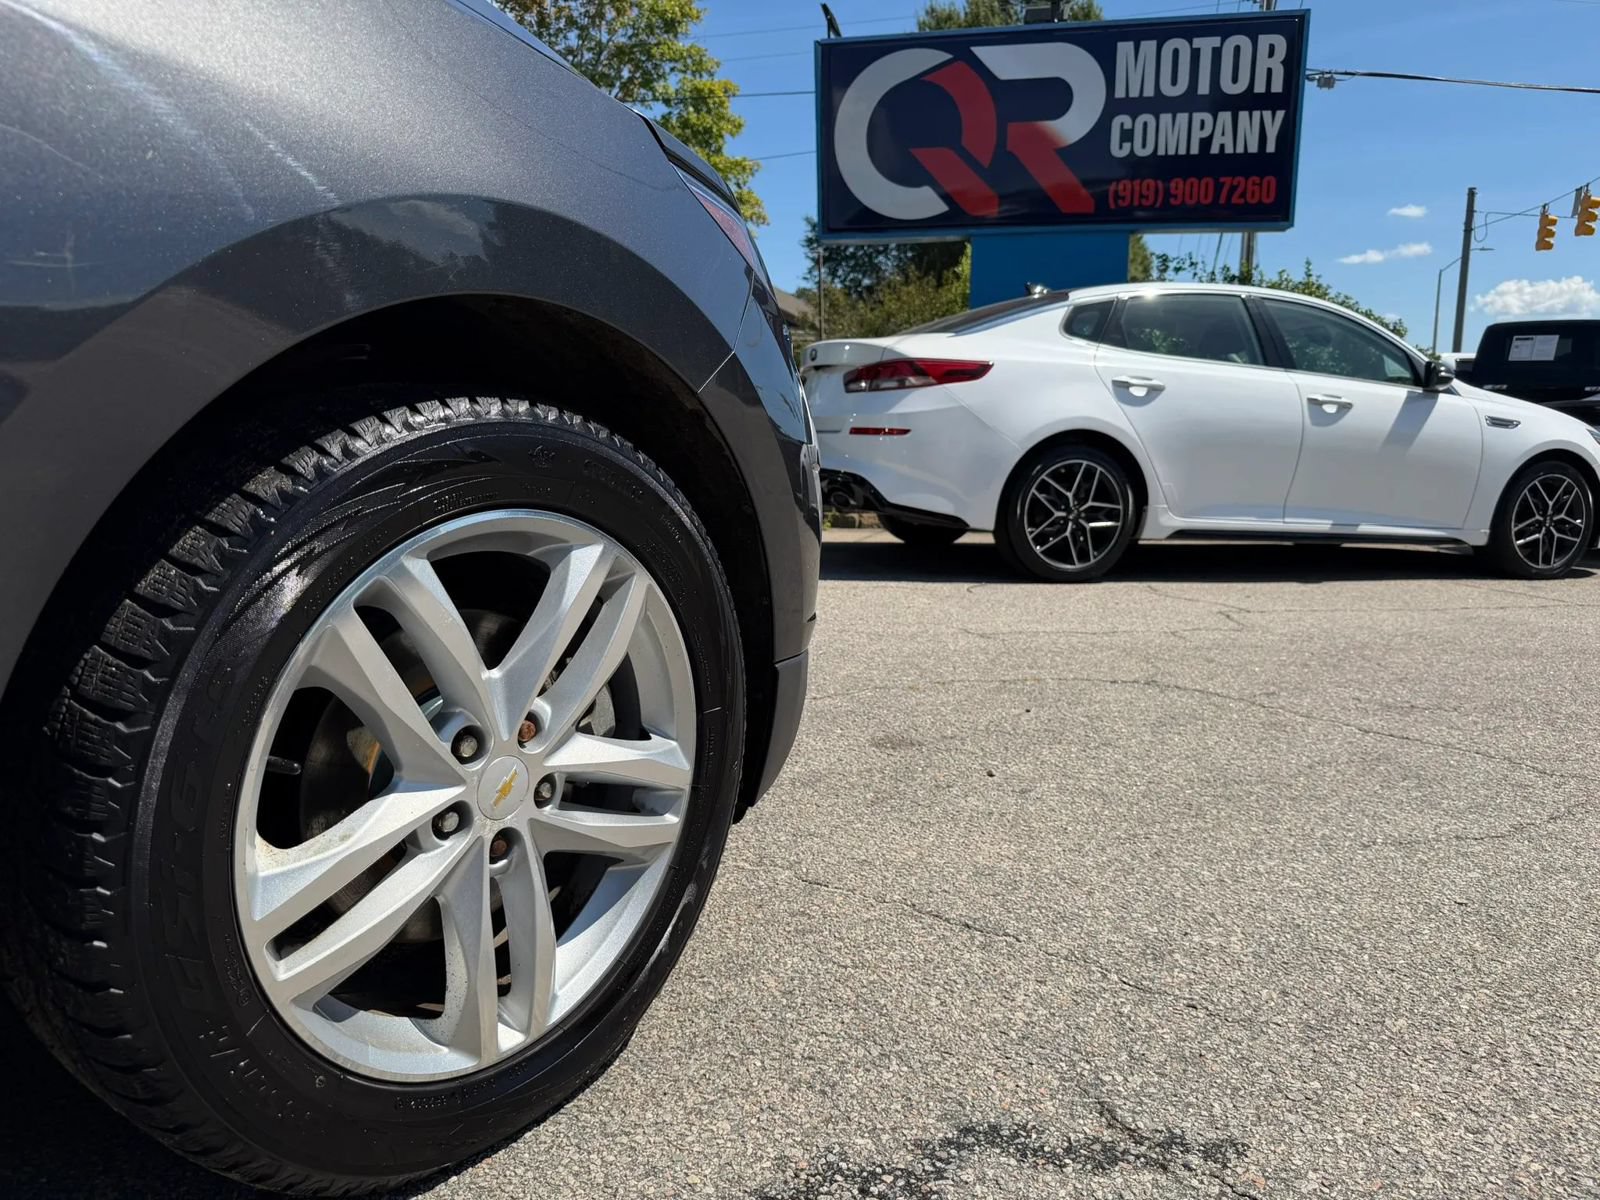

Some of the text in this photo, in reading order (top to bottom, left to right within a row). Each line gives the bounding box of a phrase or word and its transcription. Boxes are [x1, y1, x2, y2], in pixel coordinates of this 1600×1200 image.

[1115, 34, 1287, 98] MOTOR
[1110, 110, 1286, 158] COMPANY
[1108, 175, 1277, 210] (919) 900 7260
